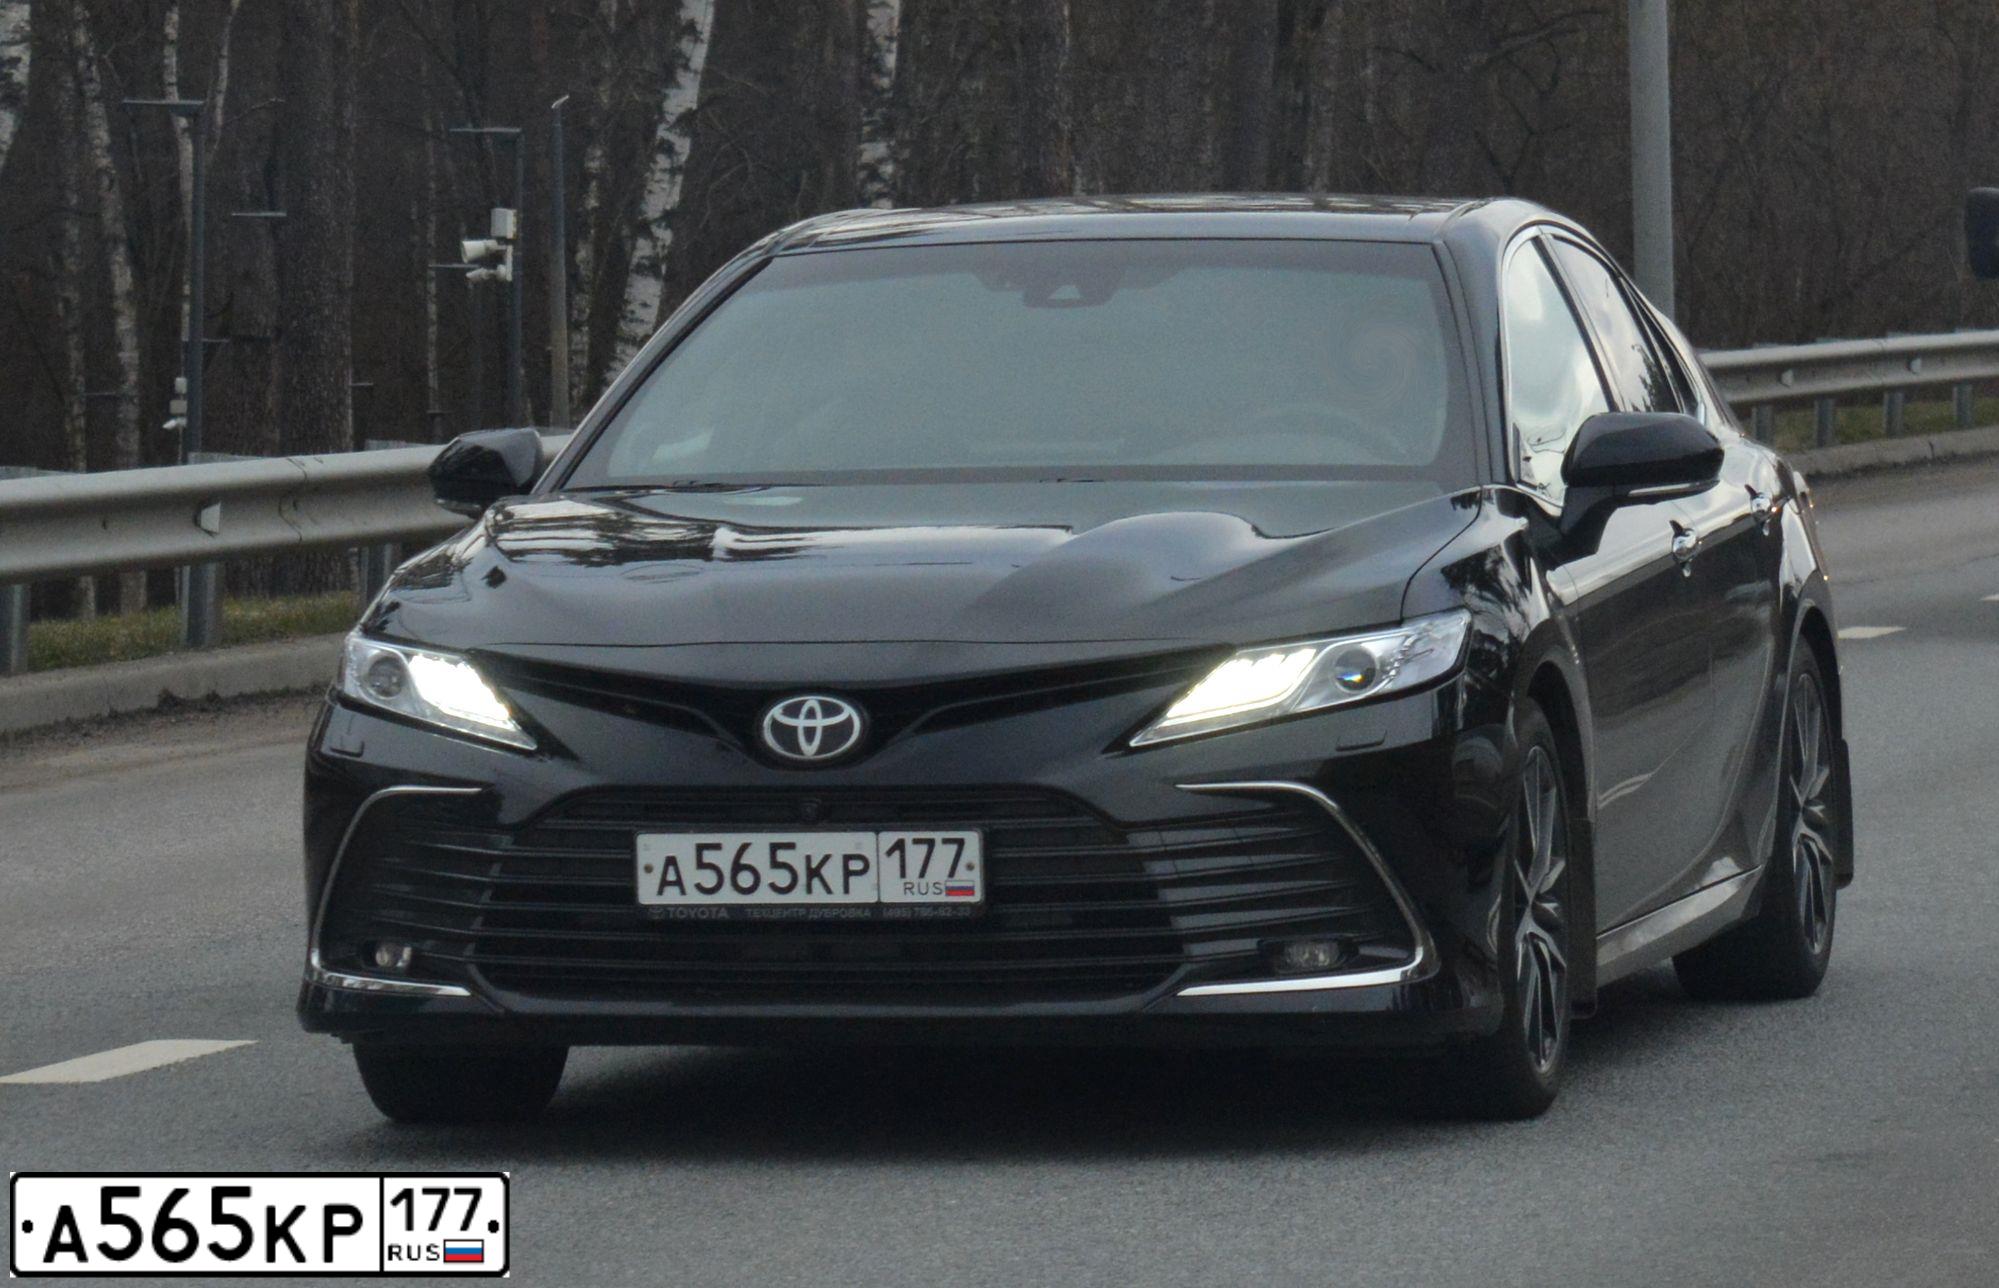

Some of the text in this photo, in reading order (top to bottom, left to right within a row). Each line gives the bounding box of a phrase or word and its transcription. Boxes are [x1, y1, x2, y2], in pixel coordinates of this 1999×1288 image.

[885, 837, 967, 880] 177
[903, 880, 943, 896] RUS
[667, 906, 730, 919] TOYOTA
[808, 907, 872, 920] ДУБРОВКА
